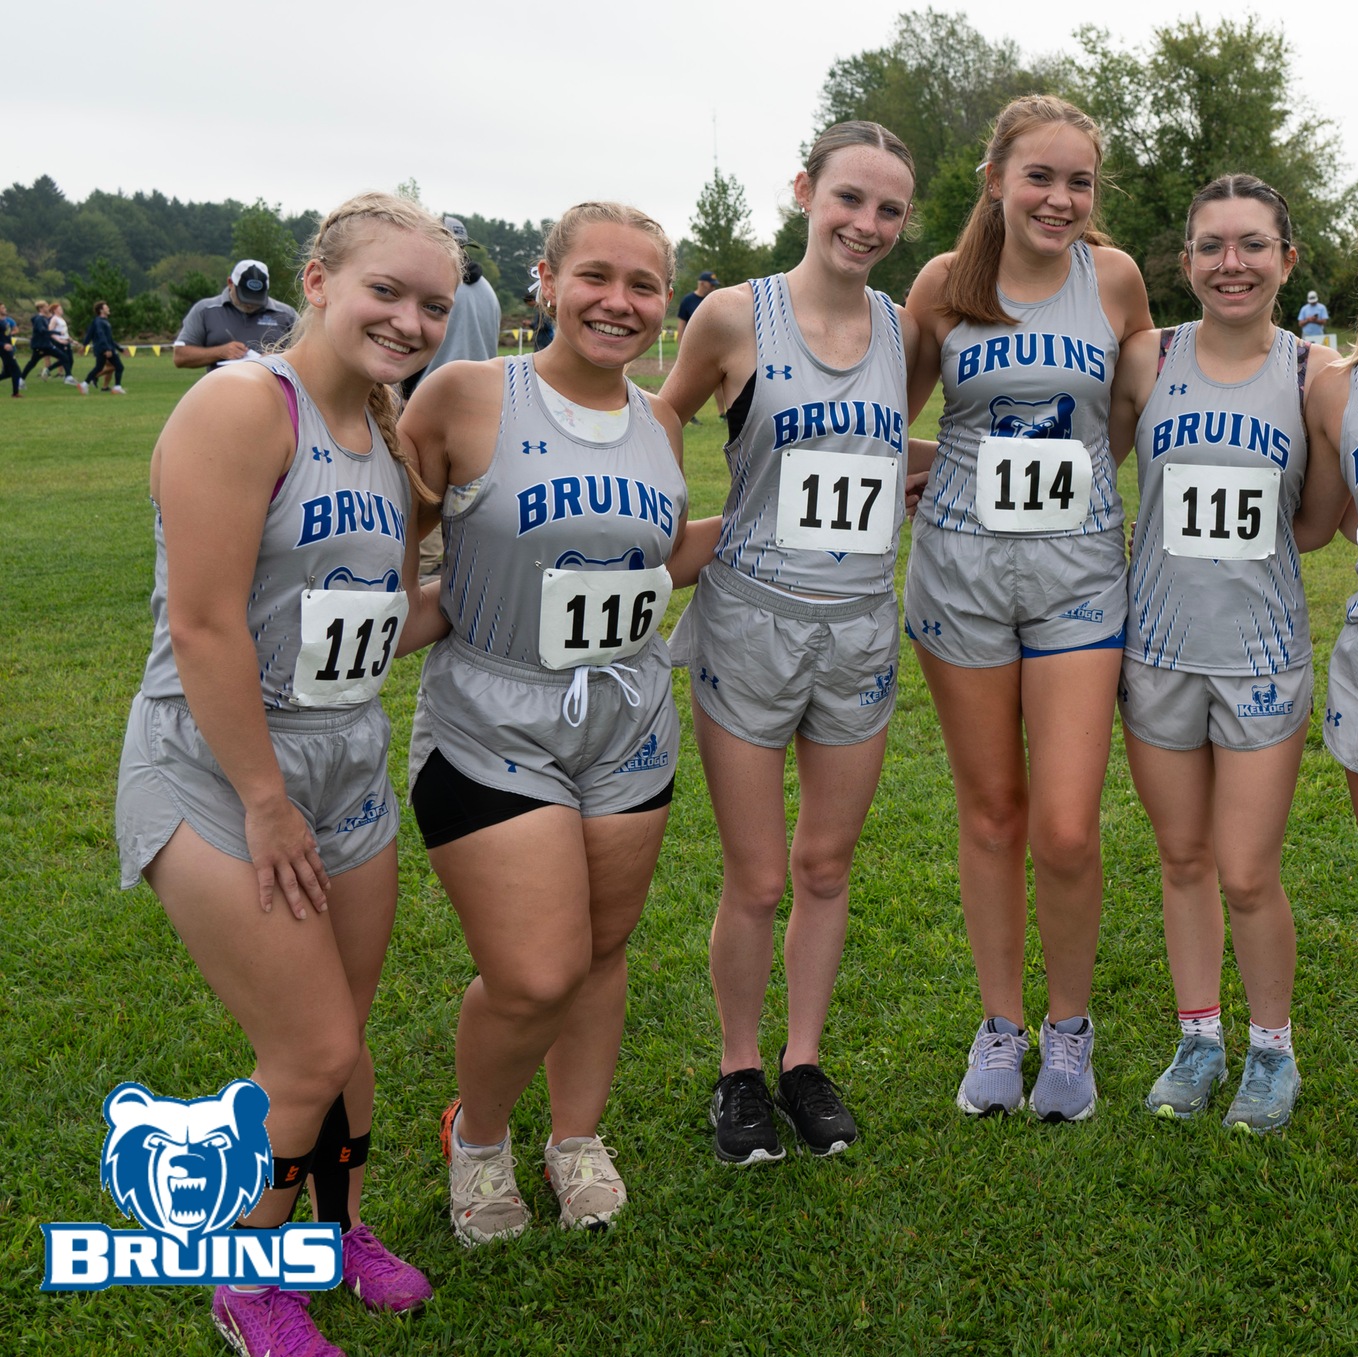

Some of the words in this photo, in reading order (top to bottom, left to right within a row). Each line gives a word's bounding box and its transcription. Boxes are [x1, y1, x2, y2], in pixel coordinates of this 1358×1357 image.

[955, 331, 1108, 385] BRUINS
[771, 398, 905, 455] BRUINS
[1150, 409, 1292, 471] BRUINS
[514, 473, 675, 539] BRUINS
[798, 472, 884, 533] 117
[993, 458, 1076, 512] 114
[1180, 485, 1264, 542] 115
[294, 488, 406, 550] BRUIN
[314, 615, 400, 682] 113
[563, 590, 658, 650] 116
[1237, 701, 1294, 717] KELLOGG
